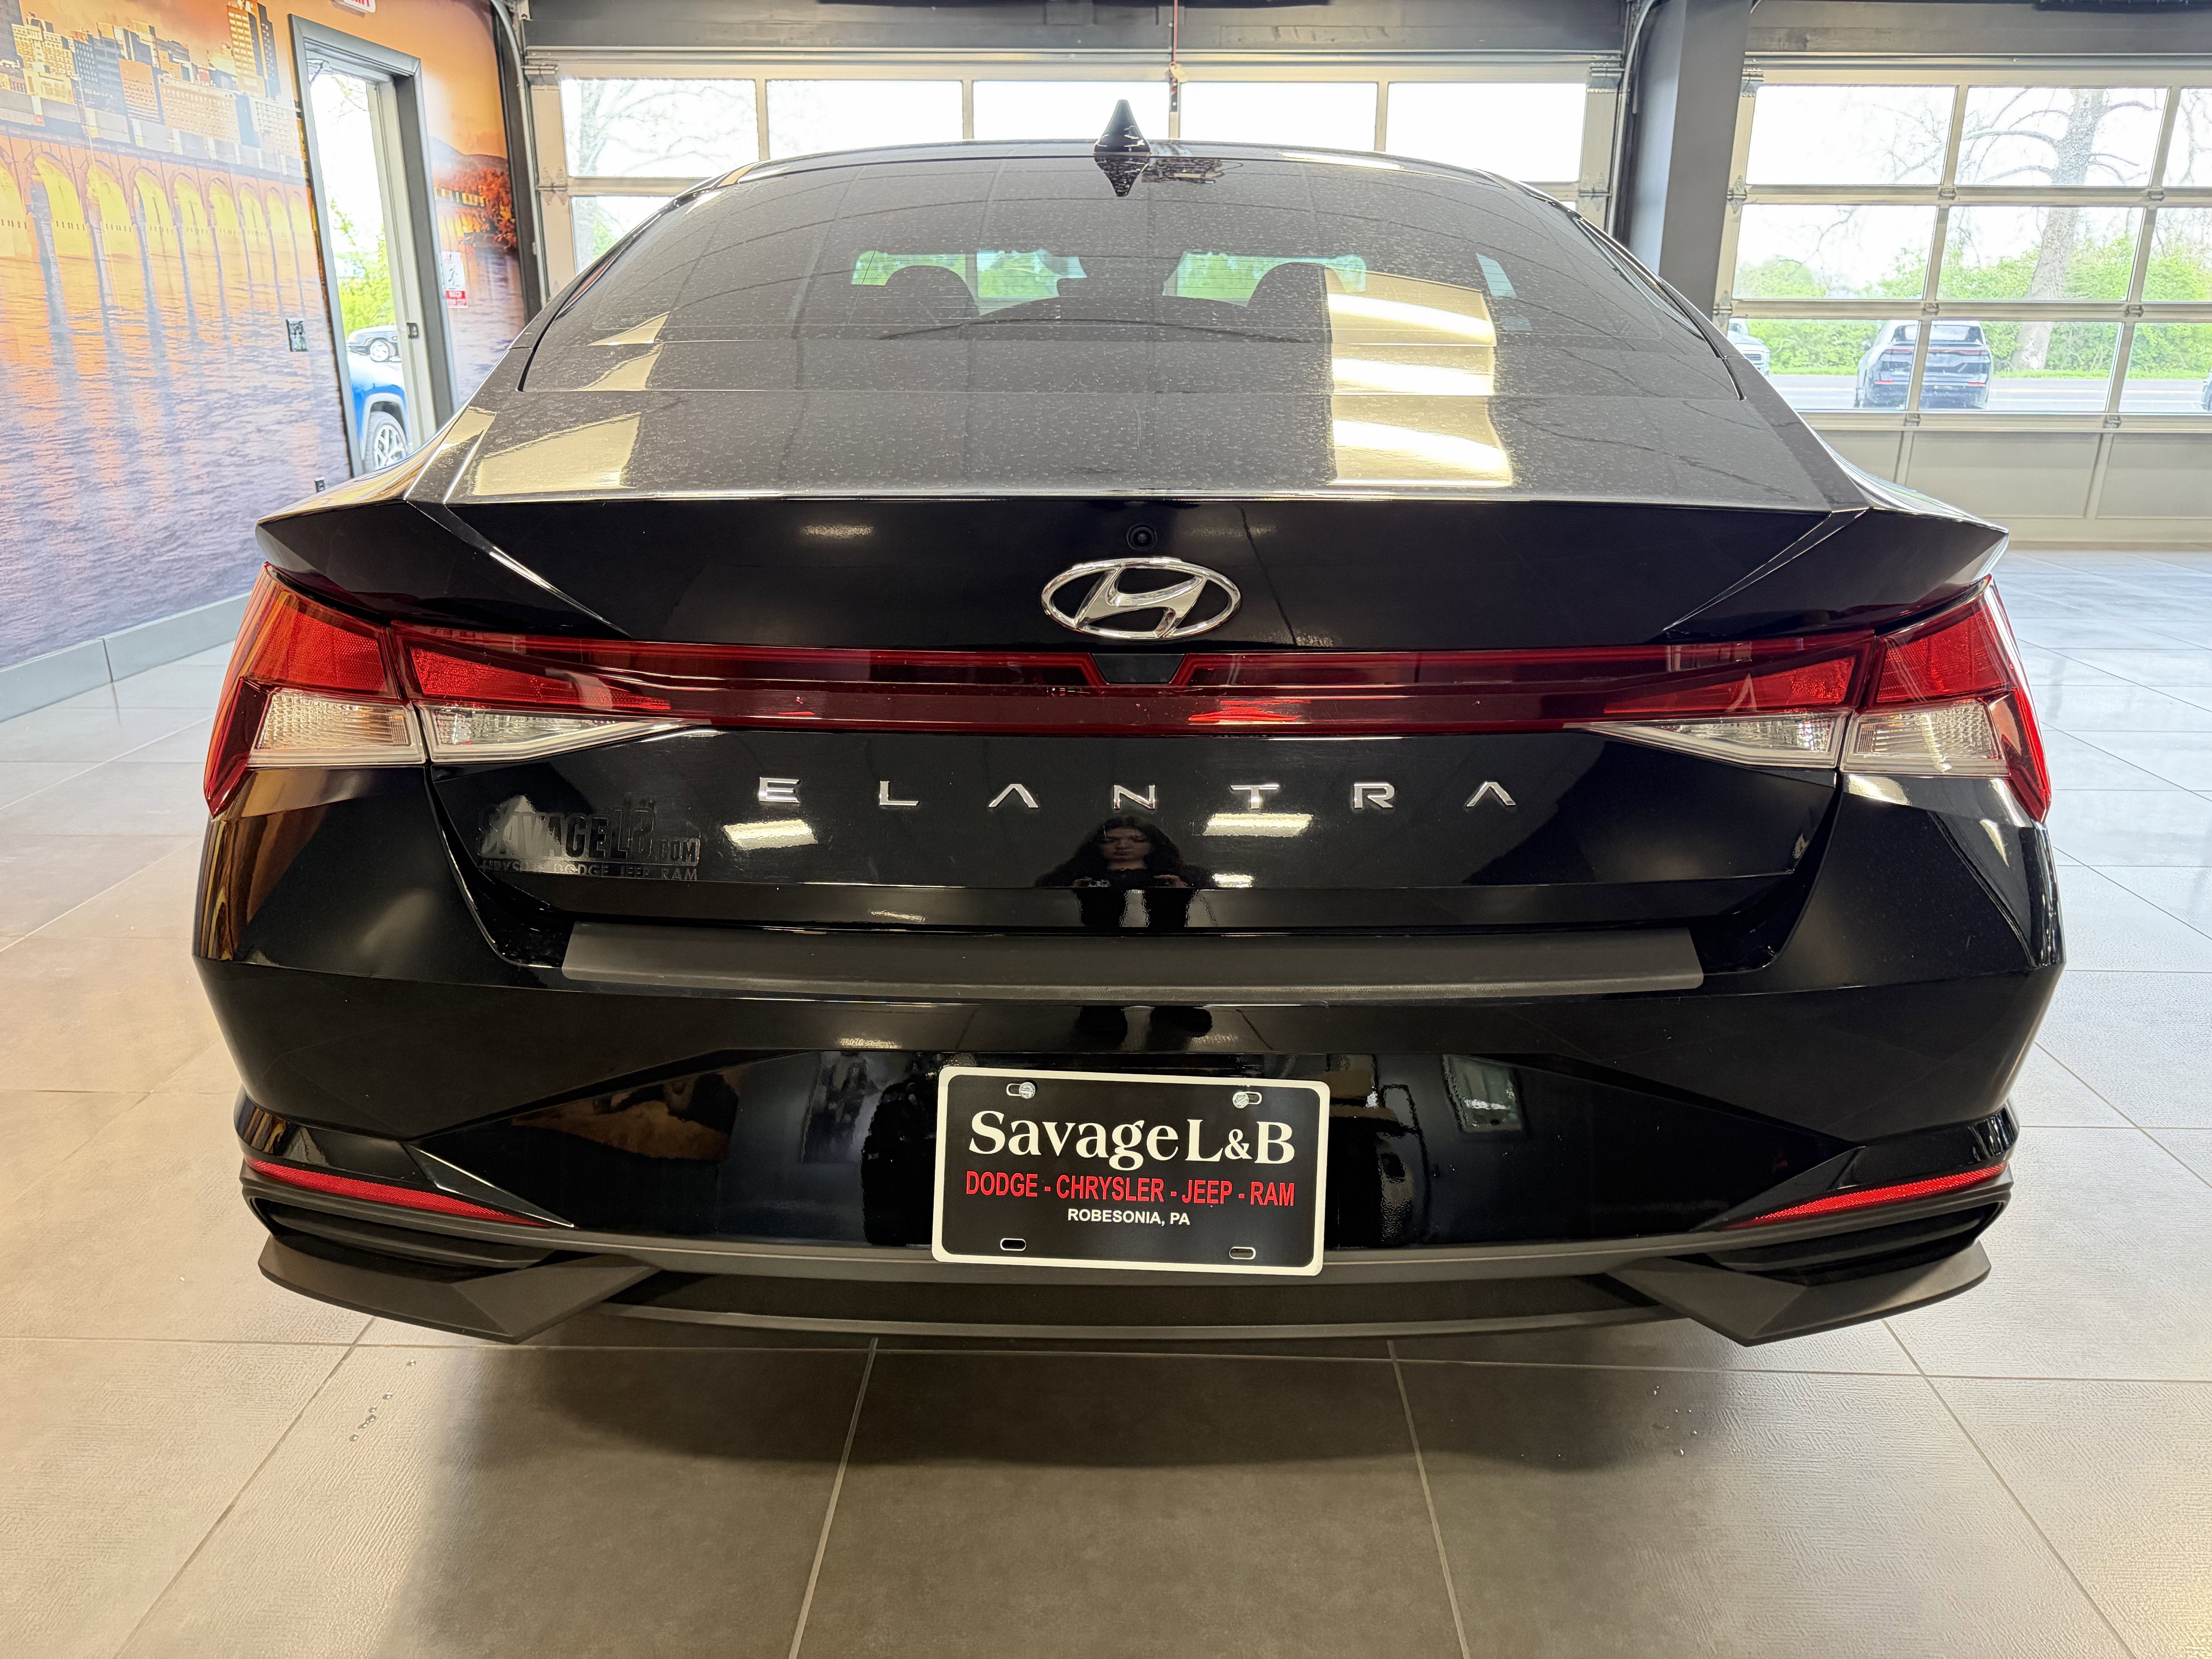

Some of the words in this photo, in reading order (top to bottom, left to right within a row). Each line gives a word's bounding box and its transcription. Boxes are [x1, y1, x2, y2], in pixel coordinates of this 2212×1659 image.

[757, 776, 1517, 809] ELANTRA
[661, 867, 697, 880] RAM
[965, 1170, 1038, 1198] DODGE
[1056, 1174, 1164, 1203] CHRYSLER
[1181, 1179, 1233, 1205] JEEP
[1250, 1181, 1295, 1207] RAM
[1068, 1208, 1165, 1227] ROBESONIA,
[1170, 1212, 1190, 1225] PA
